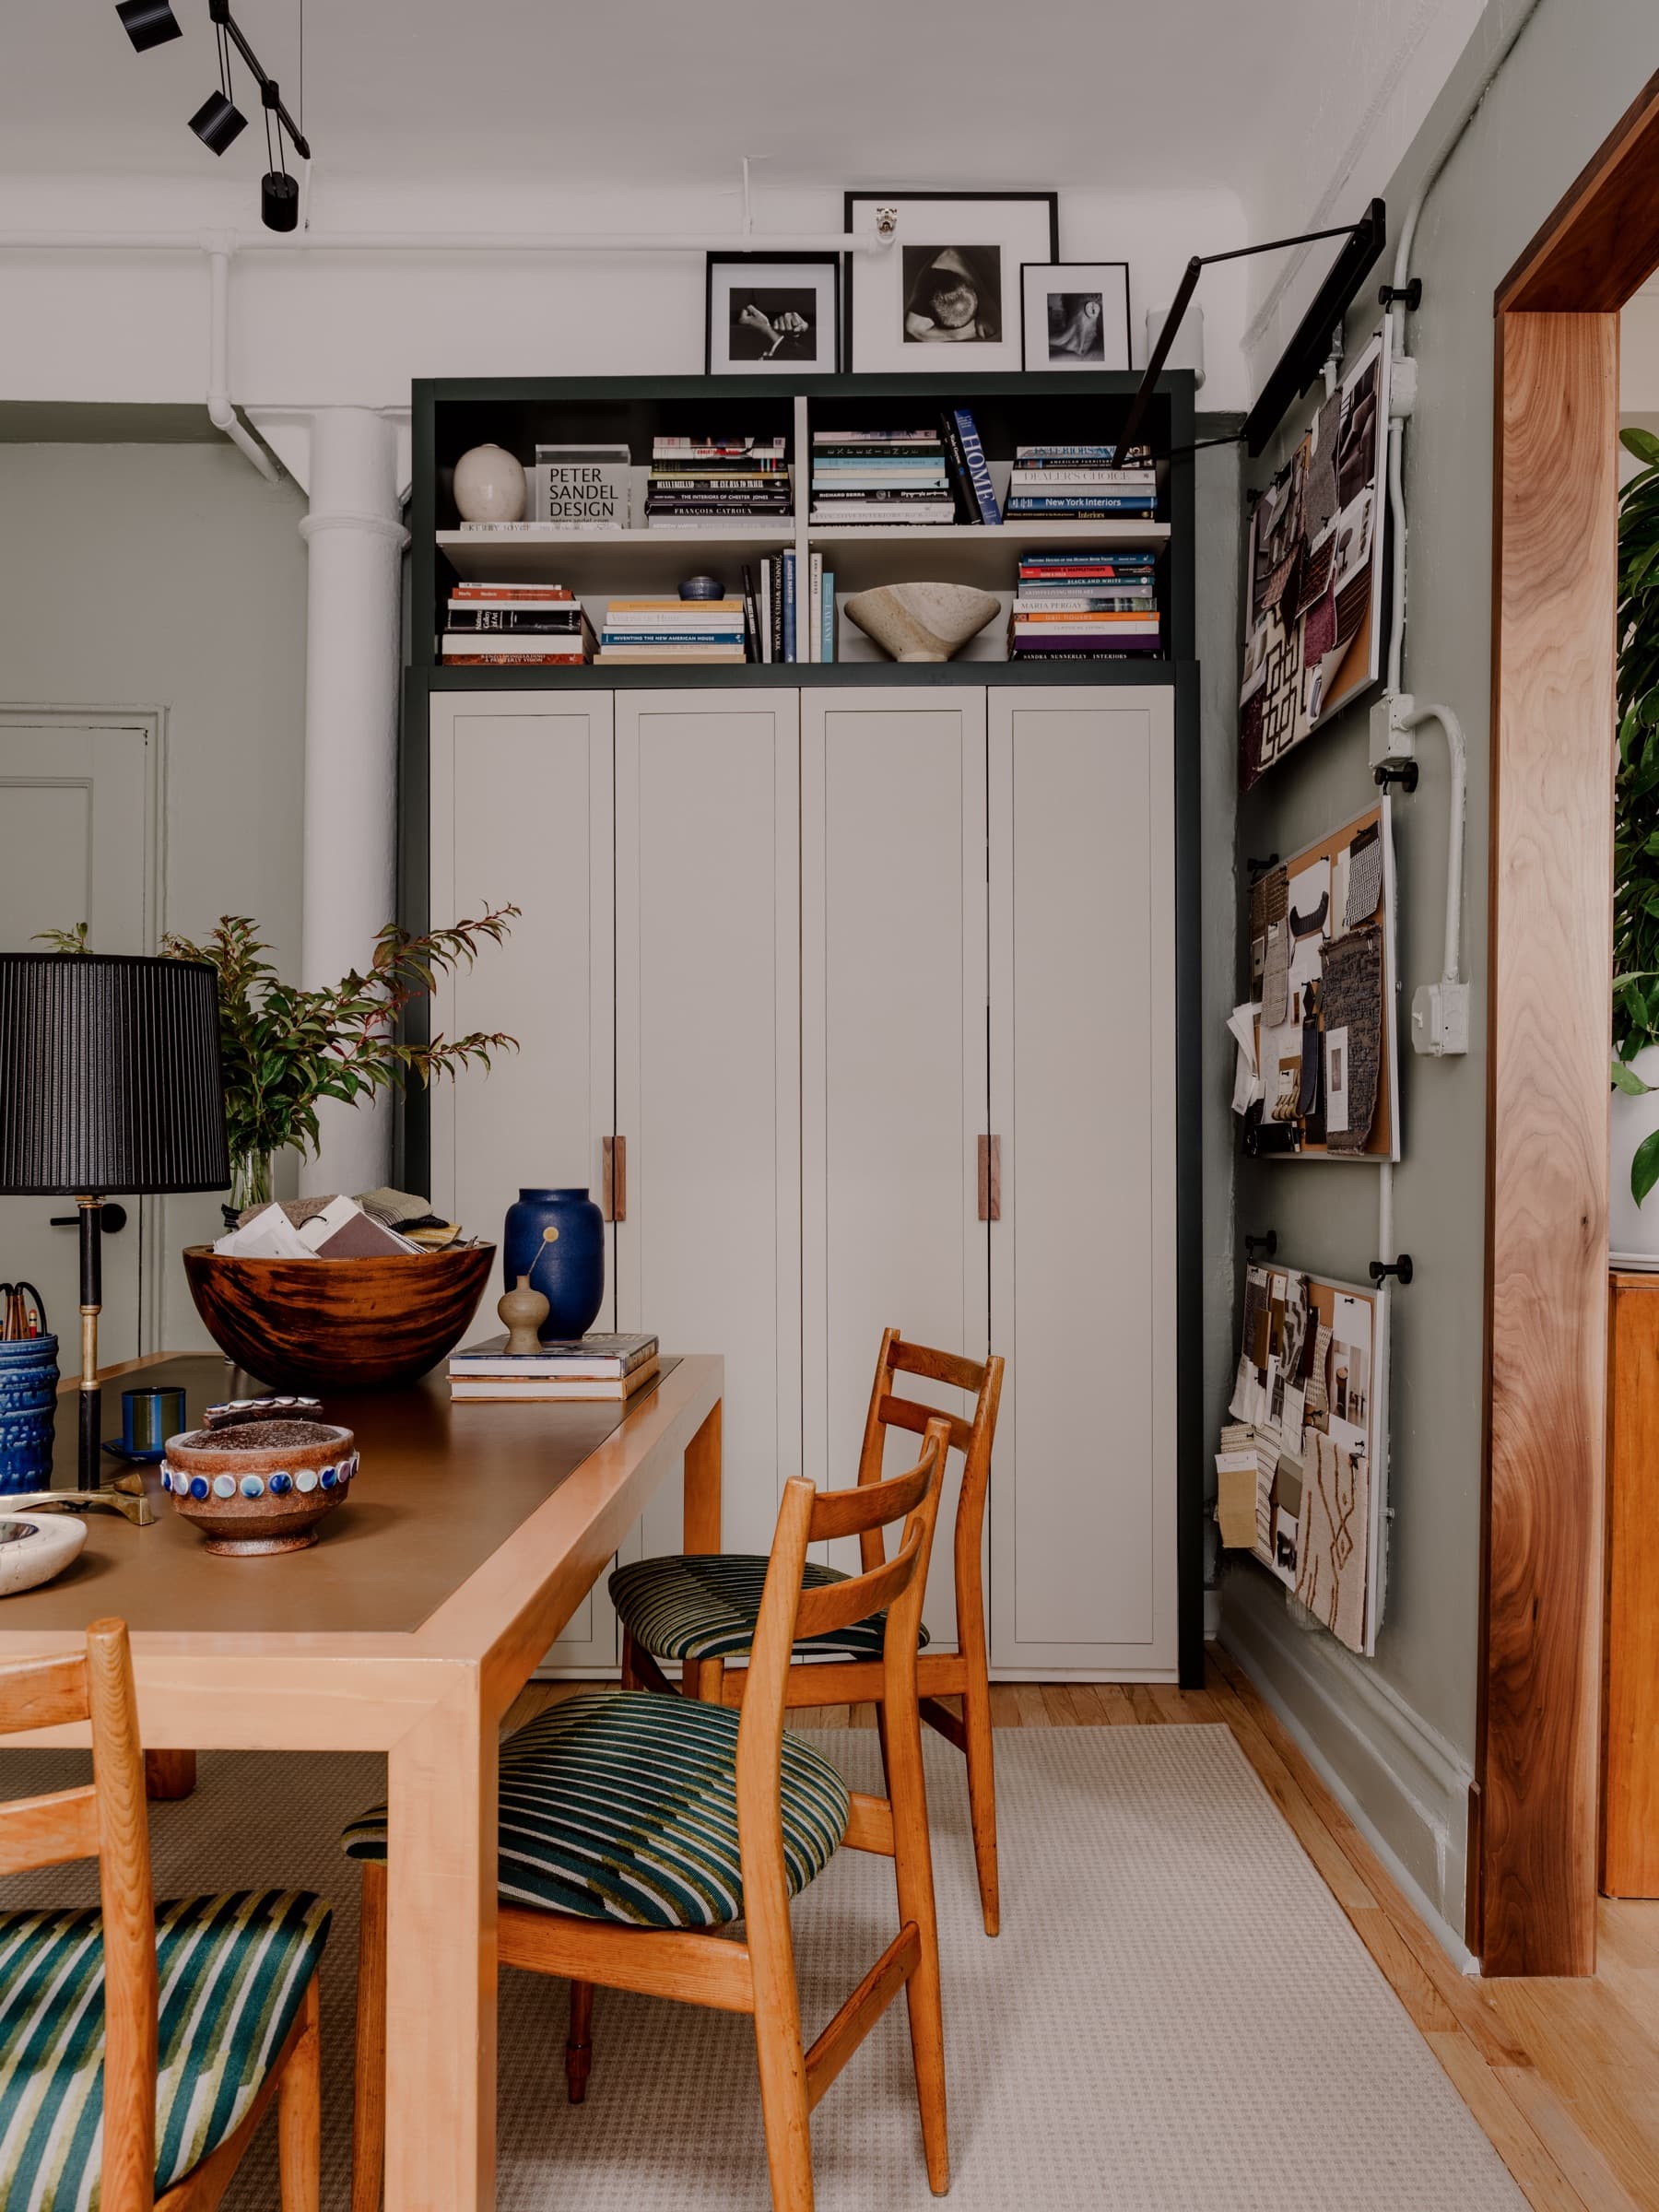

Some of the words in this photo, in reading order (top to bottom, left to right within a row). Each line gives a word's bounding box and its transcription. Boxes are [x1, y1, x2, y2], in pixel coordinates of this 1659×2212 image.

[550, 468, 602, 483] PETER
[960, 434, 995, 505] HOME
[1024, 471, 1081, 480] DEALER'S
[1083, 471, 1130, 480] CHOICE
[549, 485, 619, 500] SANDEL
[550, 501, 615, 517] DESIGN
[1045, 498, 1065, 507] New
[1065, 498, 1085, 507] York
[1086, 498, 1122, 507] Interiors
[1077, 511, 1105, 519] Interiors
